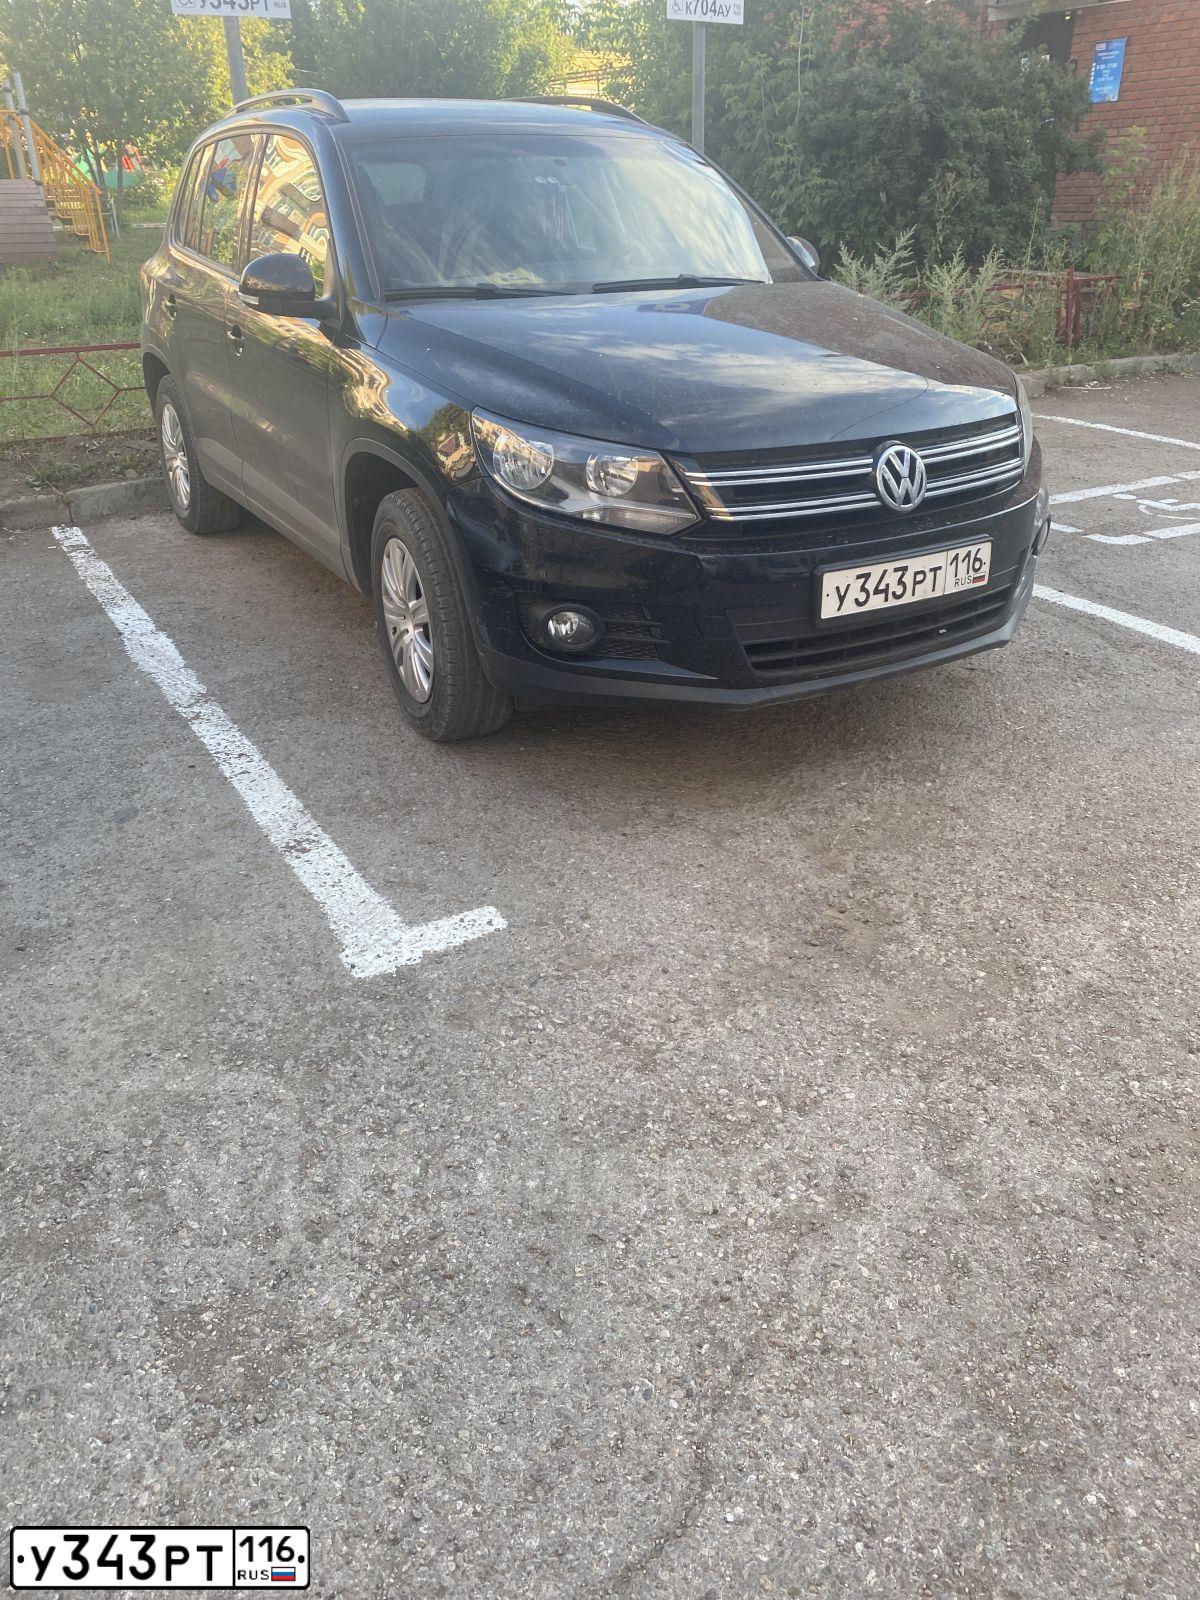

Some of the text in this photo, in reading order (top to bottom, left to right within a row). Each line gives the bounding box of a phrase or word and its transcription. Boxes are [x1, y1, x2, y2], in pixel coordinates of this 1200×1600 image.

[835, 548, 983, 612] У343РТ 116
[954, 574, 972, 588] RUS
